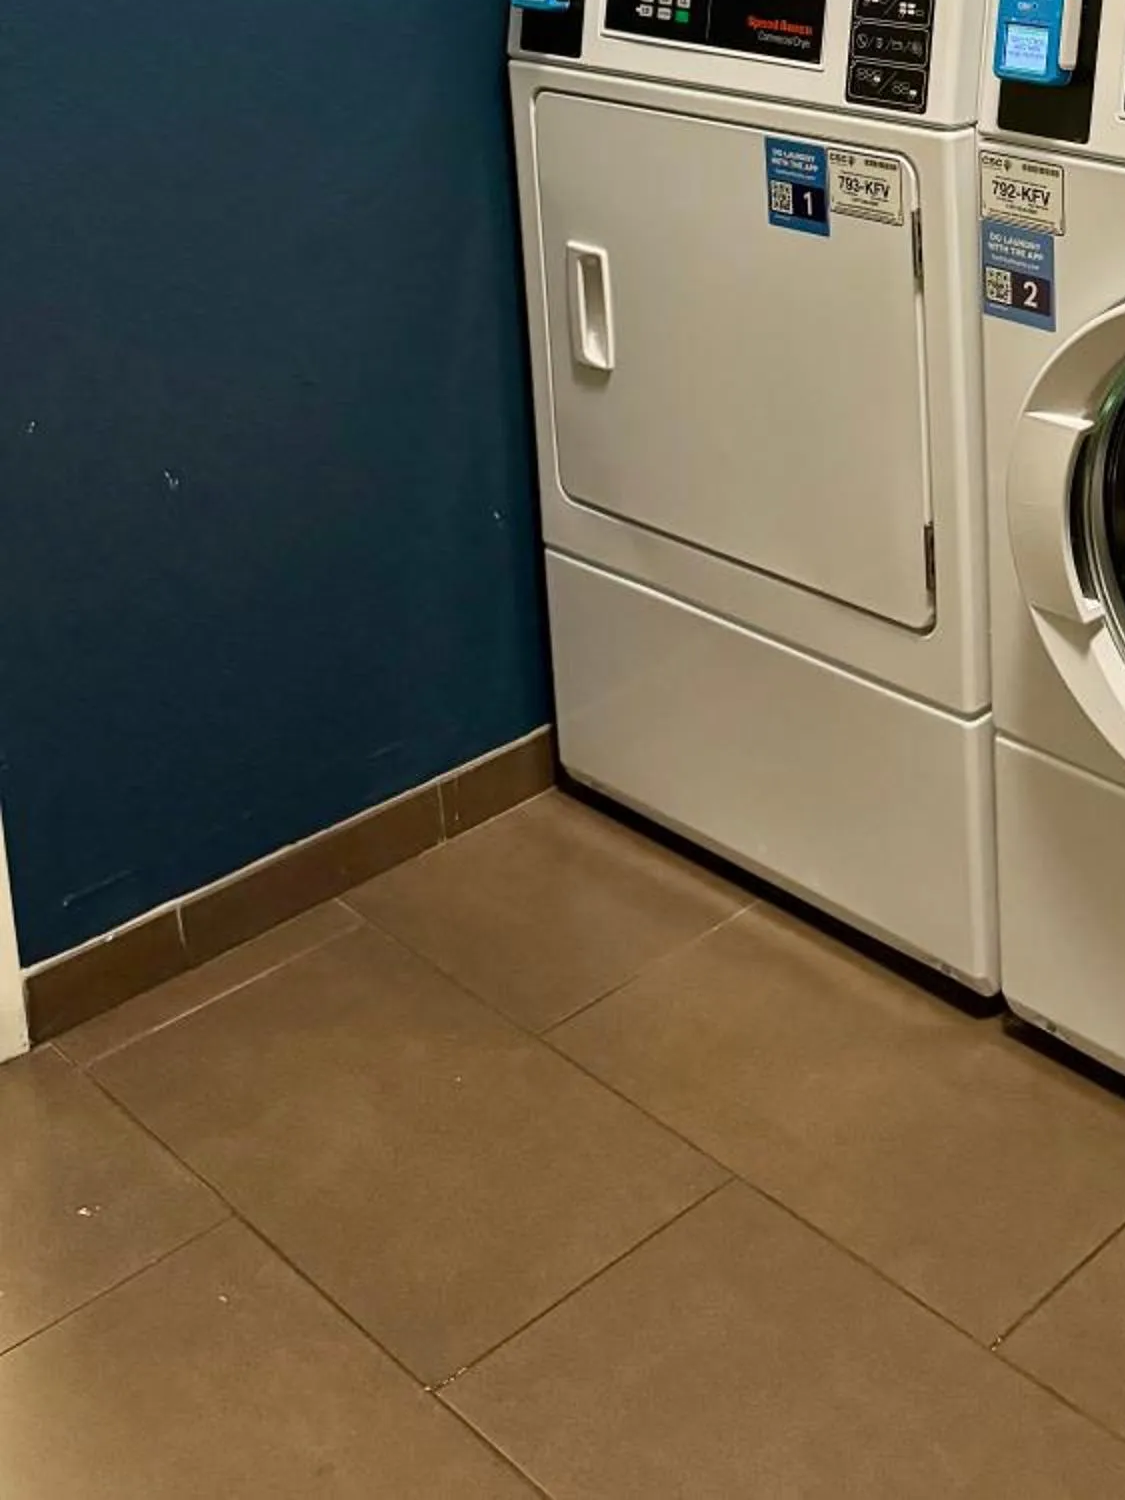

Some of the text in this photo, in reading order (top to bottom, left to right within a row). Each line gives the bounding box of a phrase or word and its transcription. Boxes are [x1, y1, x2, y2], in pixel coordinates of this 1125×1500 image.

[748, 14, 779, 30] Speed
[838, 175, 891, 198] 793-KFV
[992, 179, 1051, 206] 792-KFV
[803, 191, 813, 216] 1
[1023, 281, 1038, 309] 2
